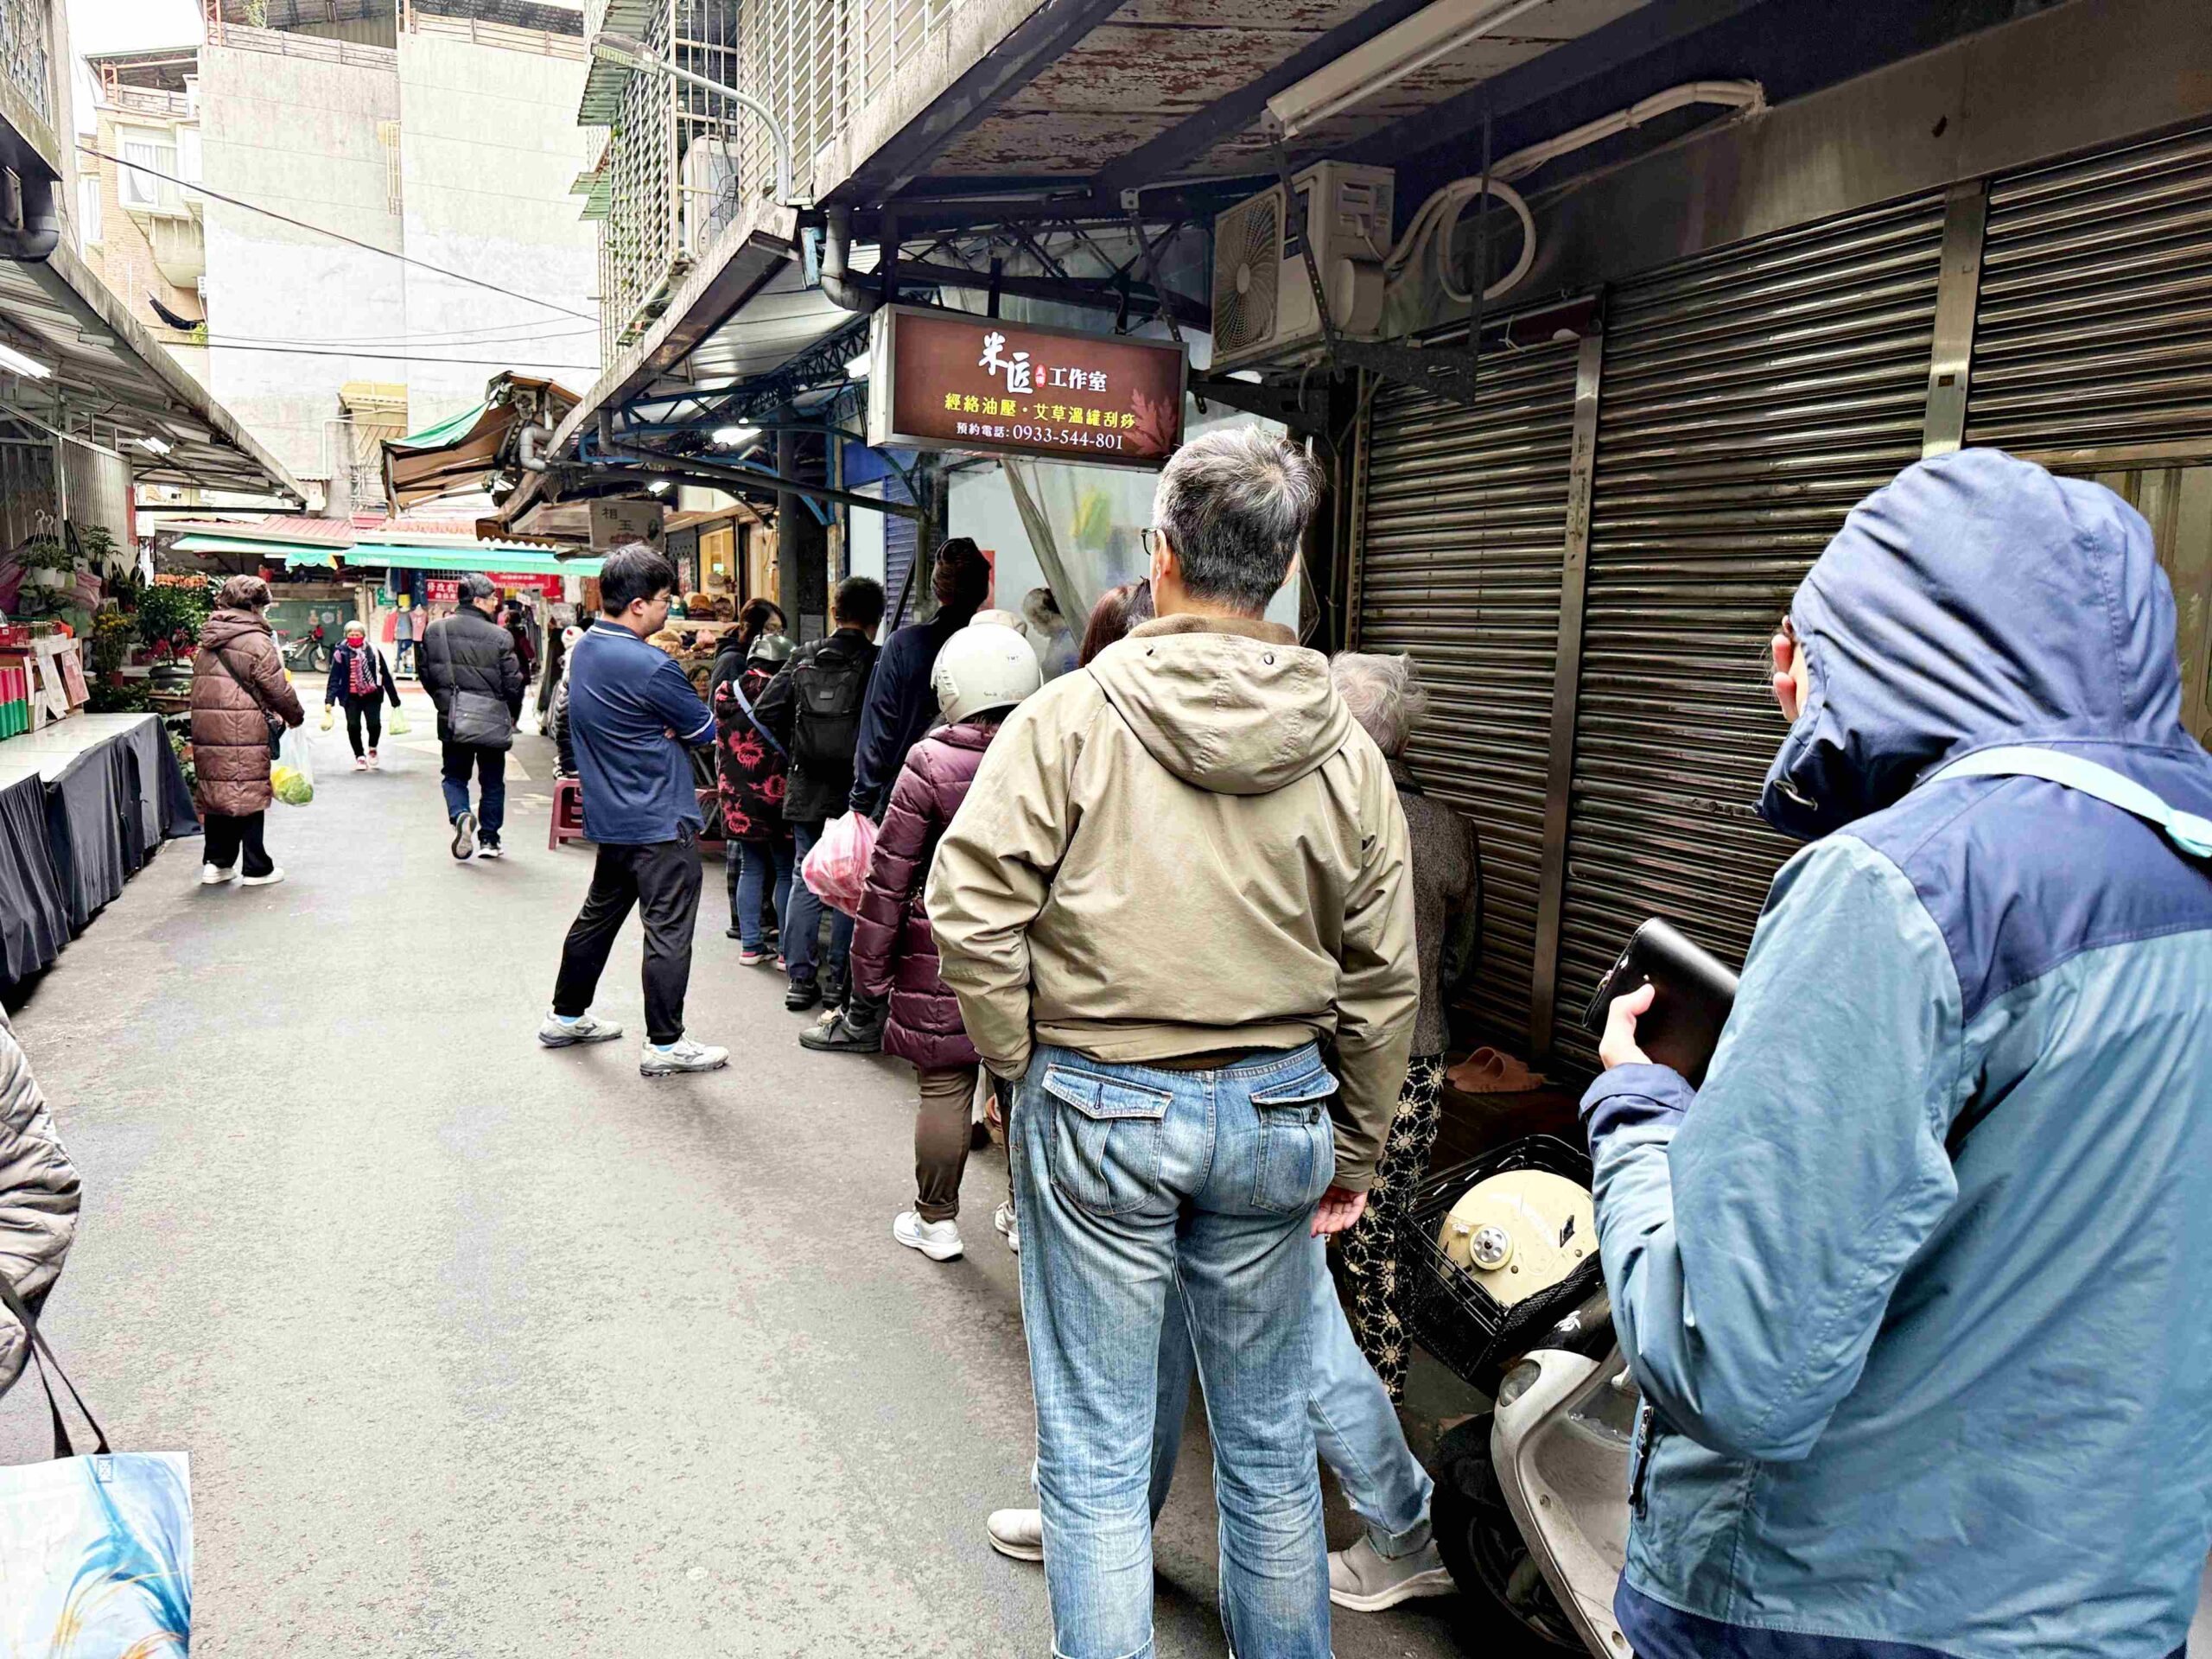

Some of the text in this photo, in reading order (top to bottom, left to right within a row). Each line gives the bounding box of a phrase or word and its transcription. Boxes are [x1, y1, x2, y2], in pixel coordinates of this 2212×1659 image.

[978, 331, 1033, 394] 米匠
[1048, 366, 1108, 392] 工作室
